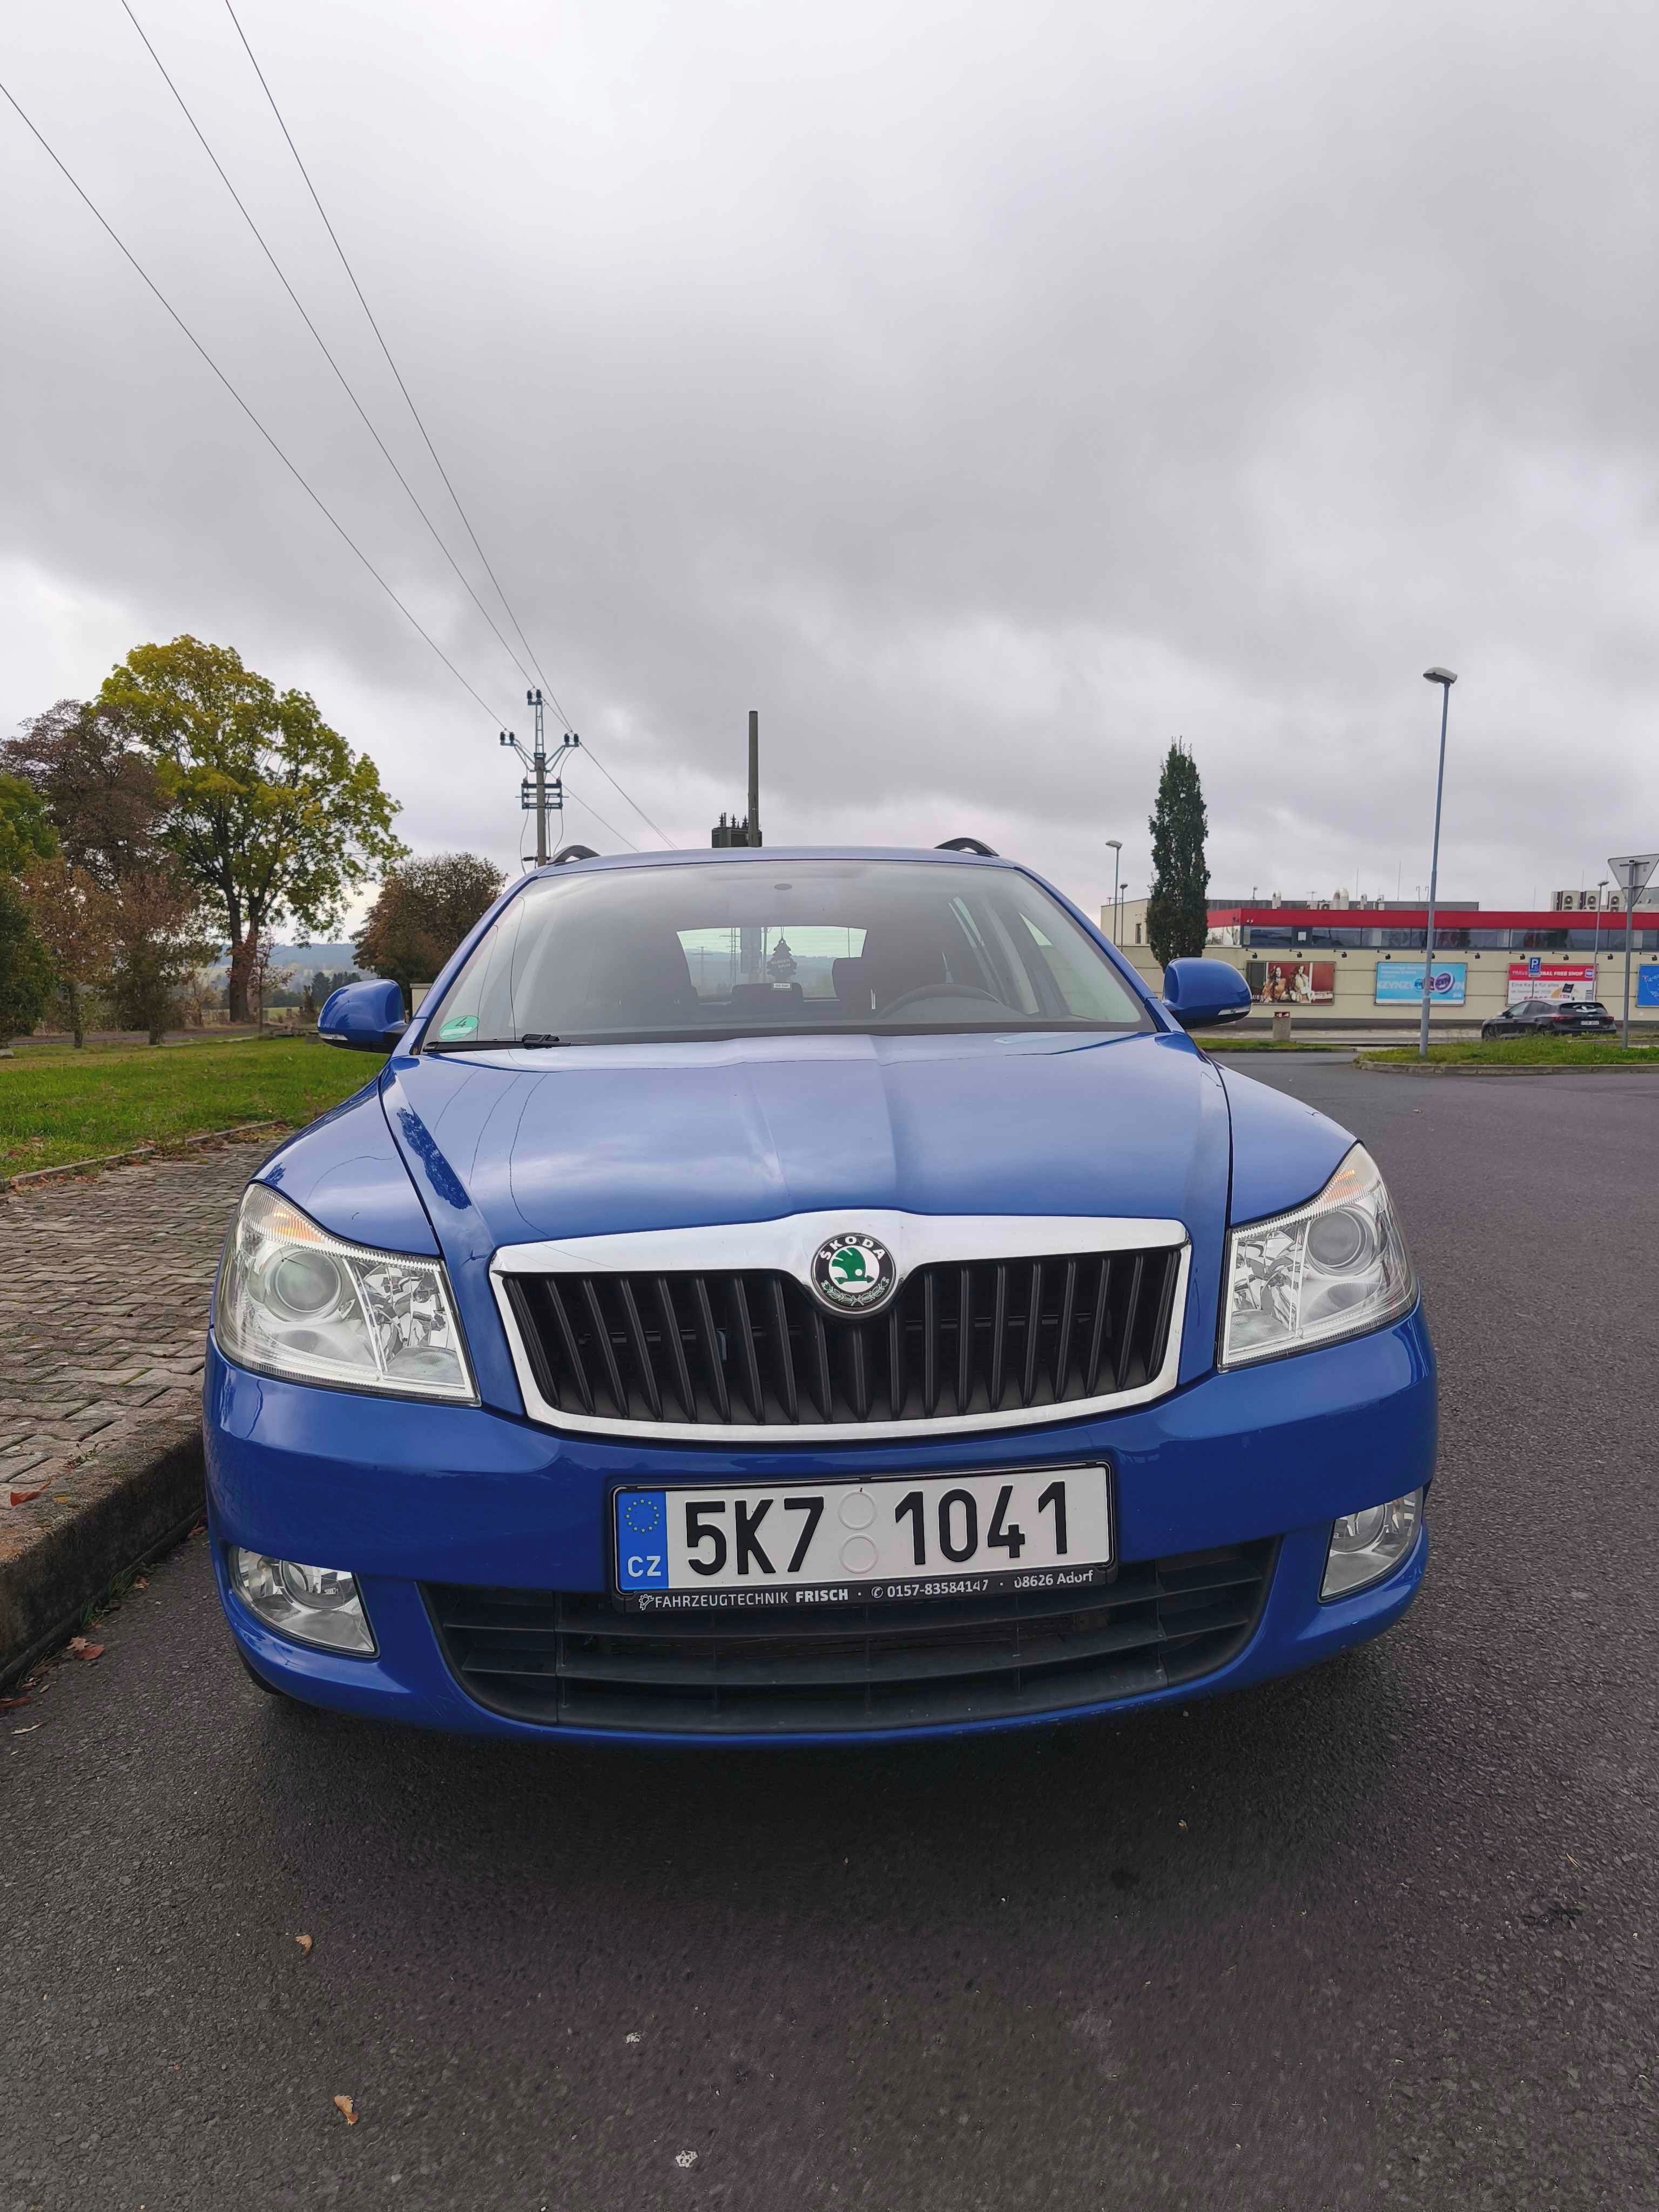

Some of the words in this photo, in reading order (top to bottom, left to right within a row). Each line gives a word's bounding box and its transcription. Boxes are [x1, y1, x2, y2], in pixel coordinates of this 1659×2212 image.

[1532, 959, 1539, 969] P
[455, 1016, 468, 1028] 4
[820, 1236, 886, 1260] ŠKODA
[685, 1496, 824, 1575] 5K7
[895, 1481, 1068, 1565] 1041
[627, 1555, 662, 1577] CZ
[655, 1592, 789, 1608] FAHRZEUGTECHNIK
[795, 1589, 848, 1603] FRISCH
[887, 1579, 989, 1598] 0157-83584147
[1014, 1574, 1053, 1589] 08626
[1056, 1570, 1094, 1585] Adorf
